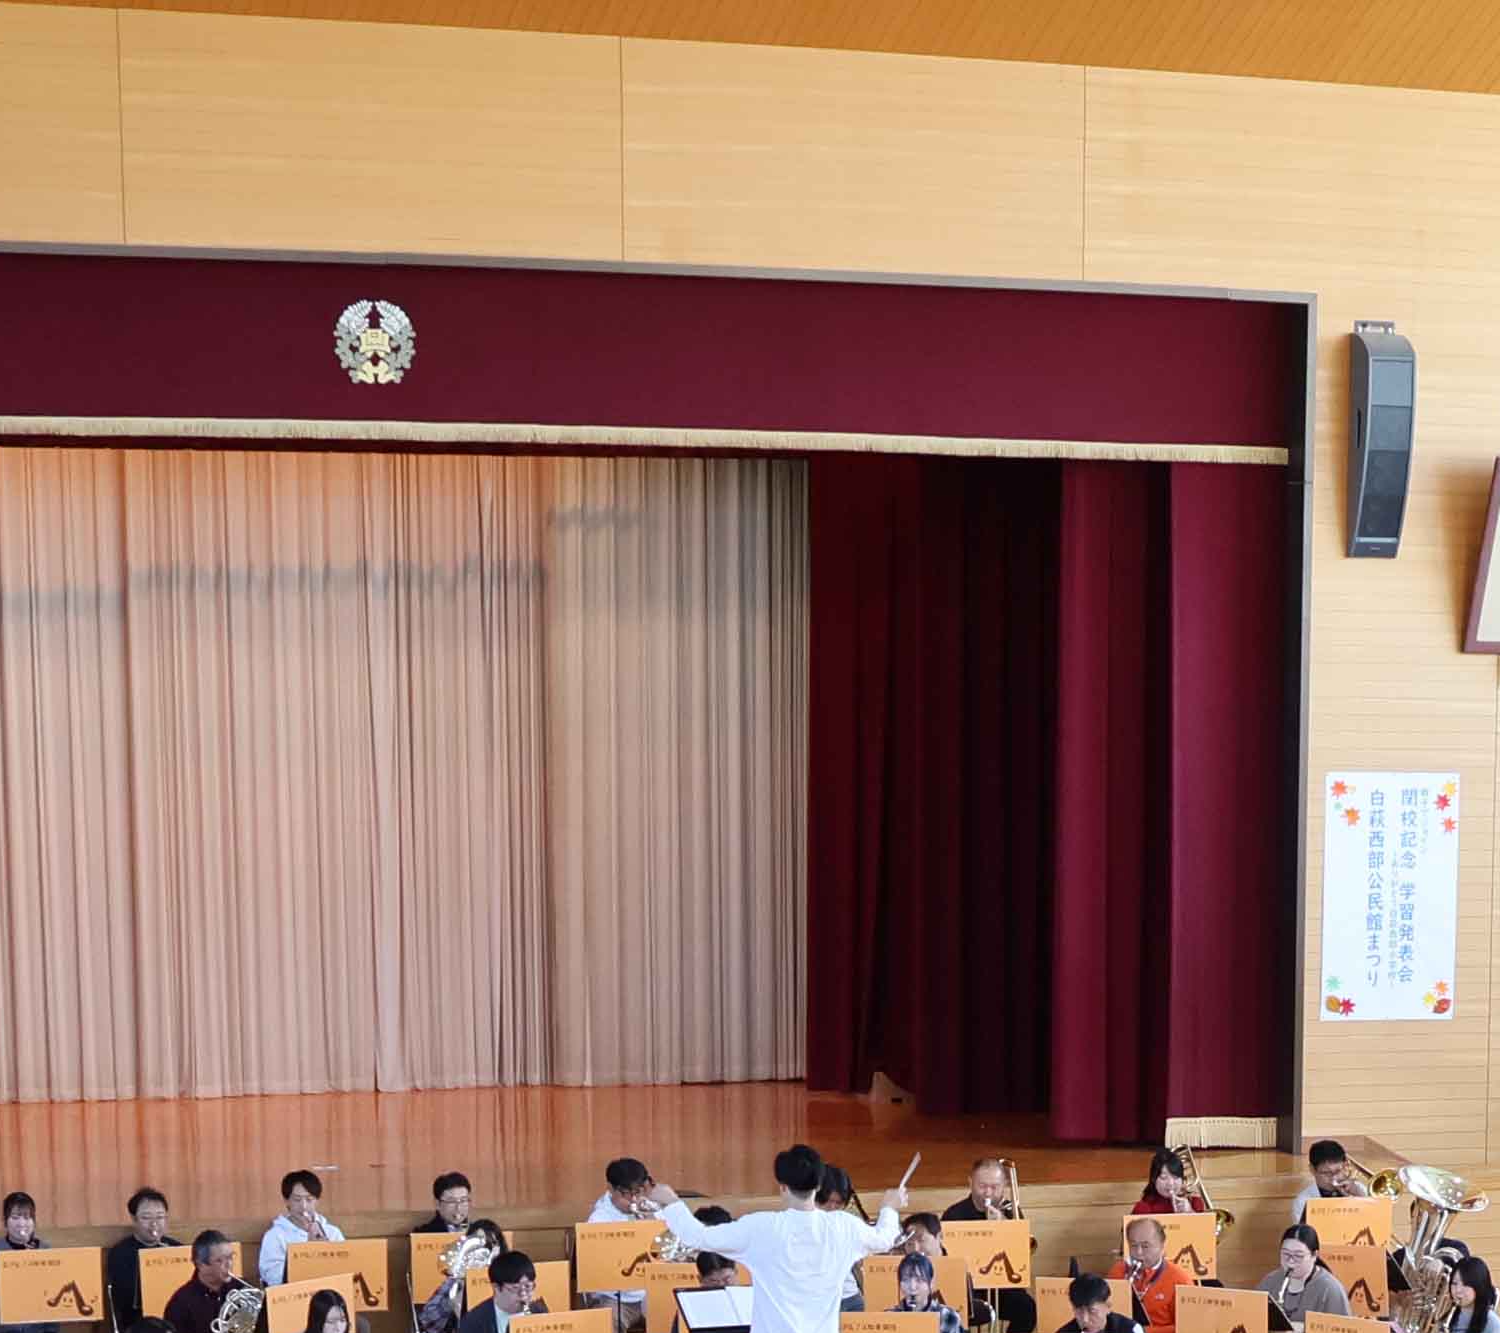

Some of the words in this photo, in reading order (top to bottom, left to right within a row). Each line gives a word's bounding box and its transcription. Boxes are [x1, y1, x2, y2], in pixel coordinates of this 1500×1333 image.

[1365, 789, 1385, 988] 白萩西部公民館まつり
